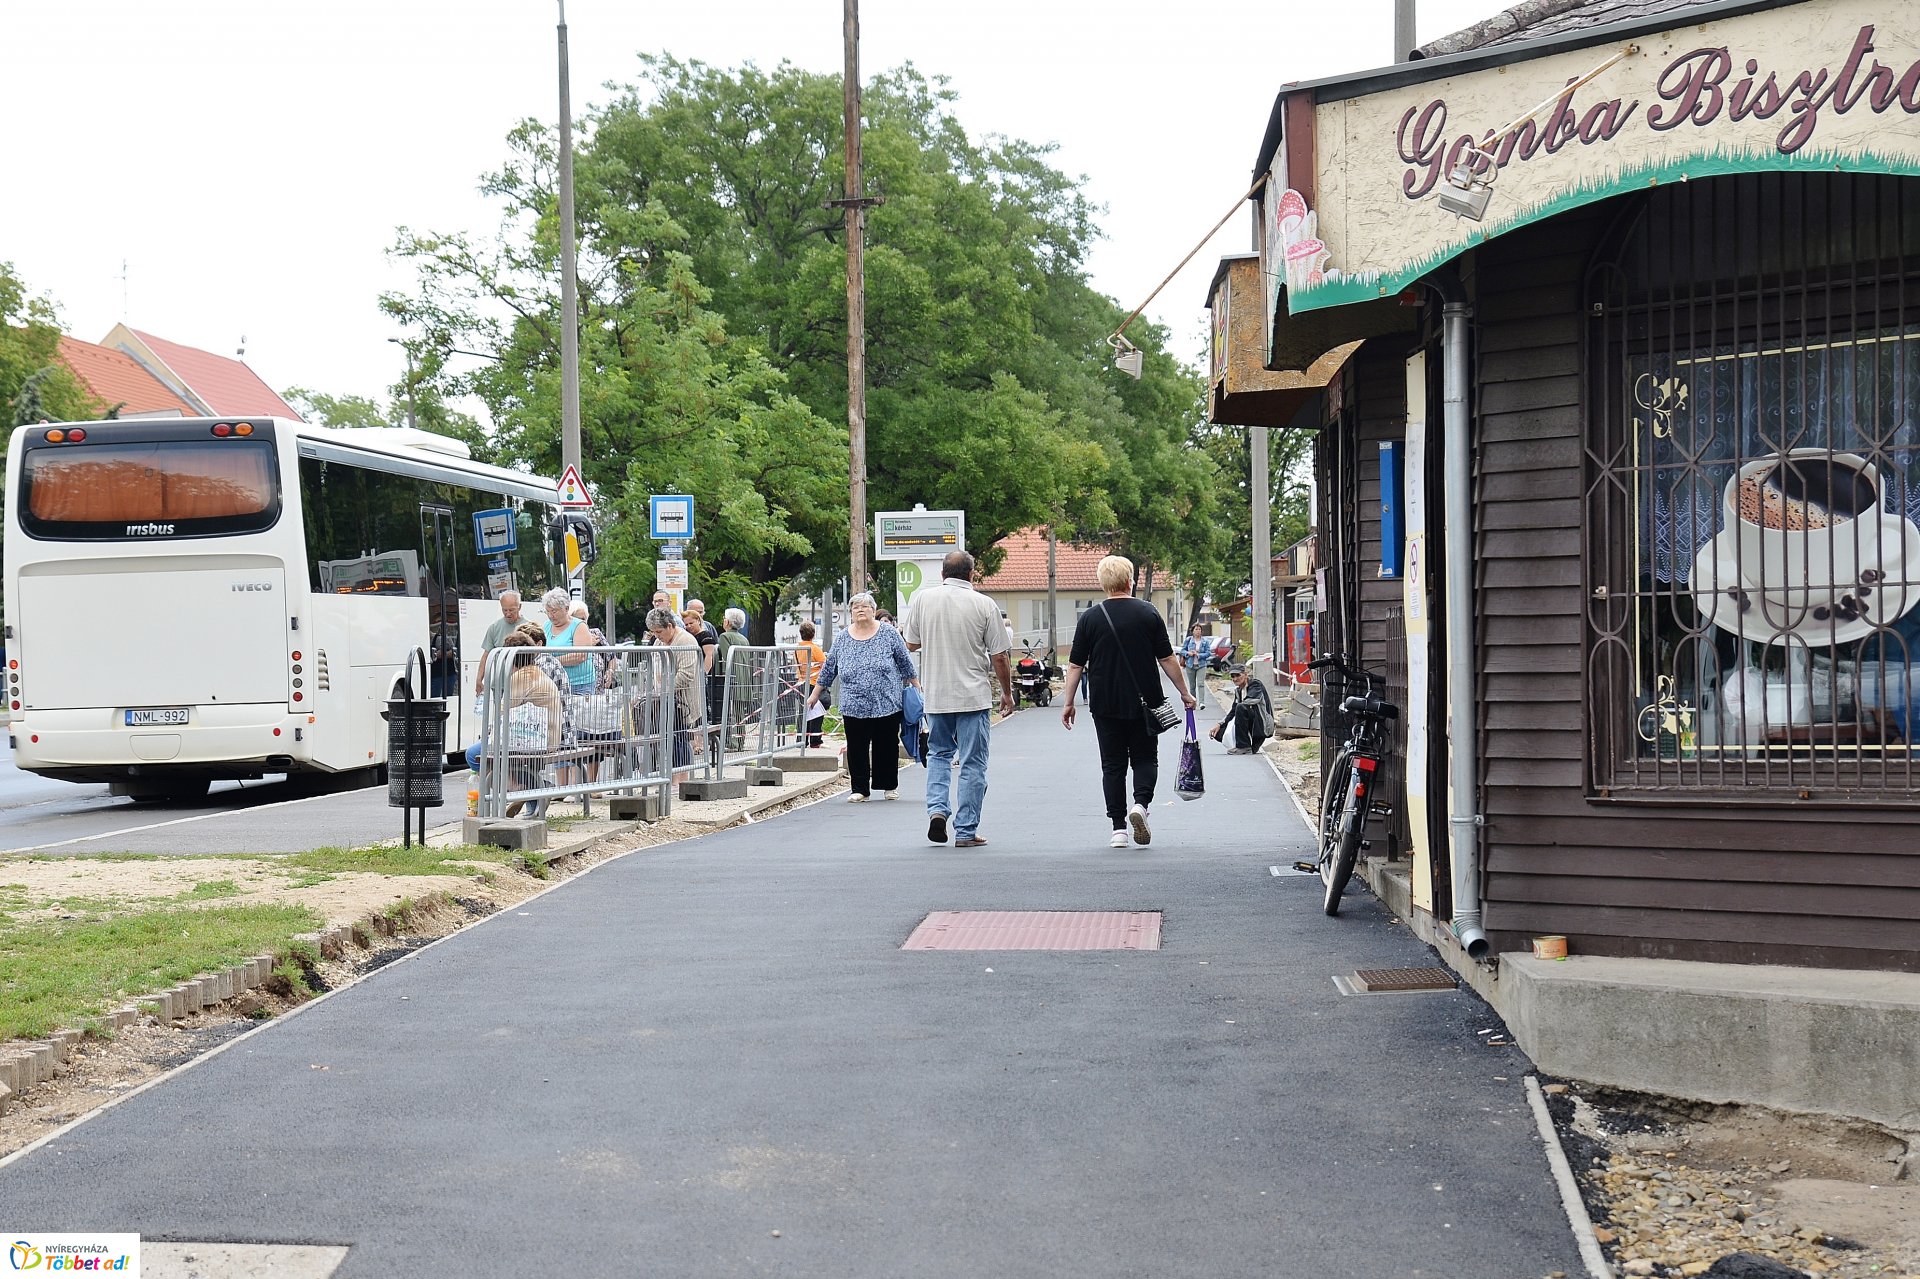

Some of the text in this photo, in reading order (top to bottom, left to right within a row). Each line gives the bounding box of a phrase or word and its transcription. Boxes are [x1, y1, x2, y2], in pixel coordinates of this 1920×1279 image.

[1397, 77, 1638, 200] Gomba
[126, 522, 175, 536] irisbus
[231, 581, 273, 592] IVECO
[134, 711, 186, 722] NML-992
